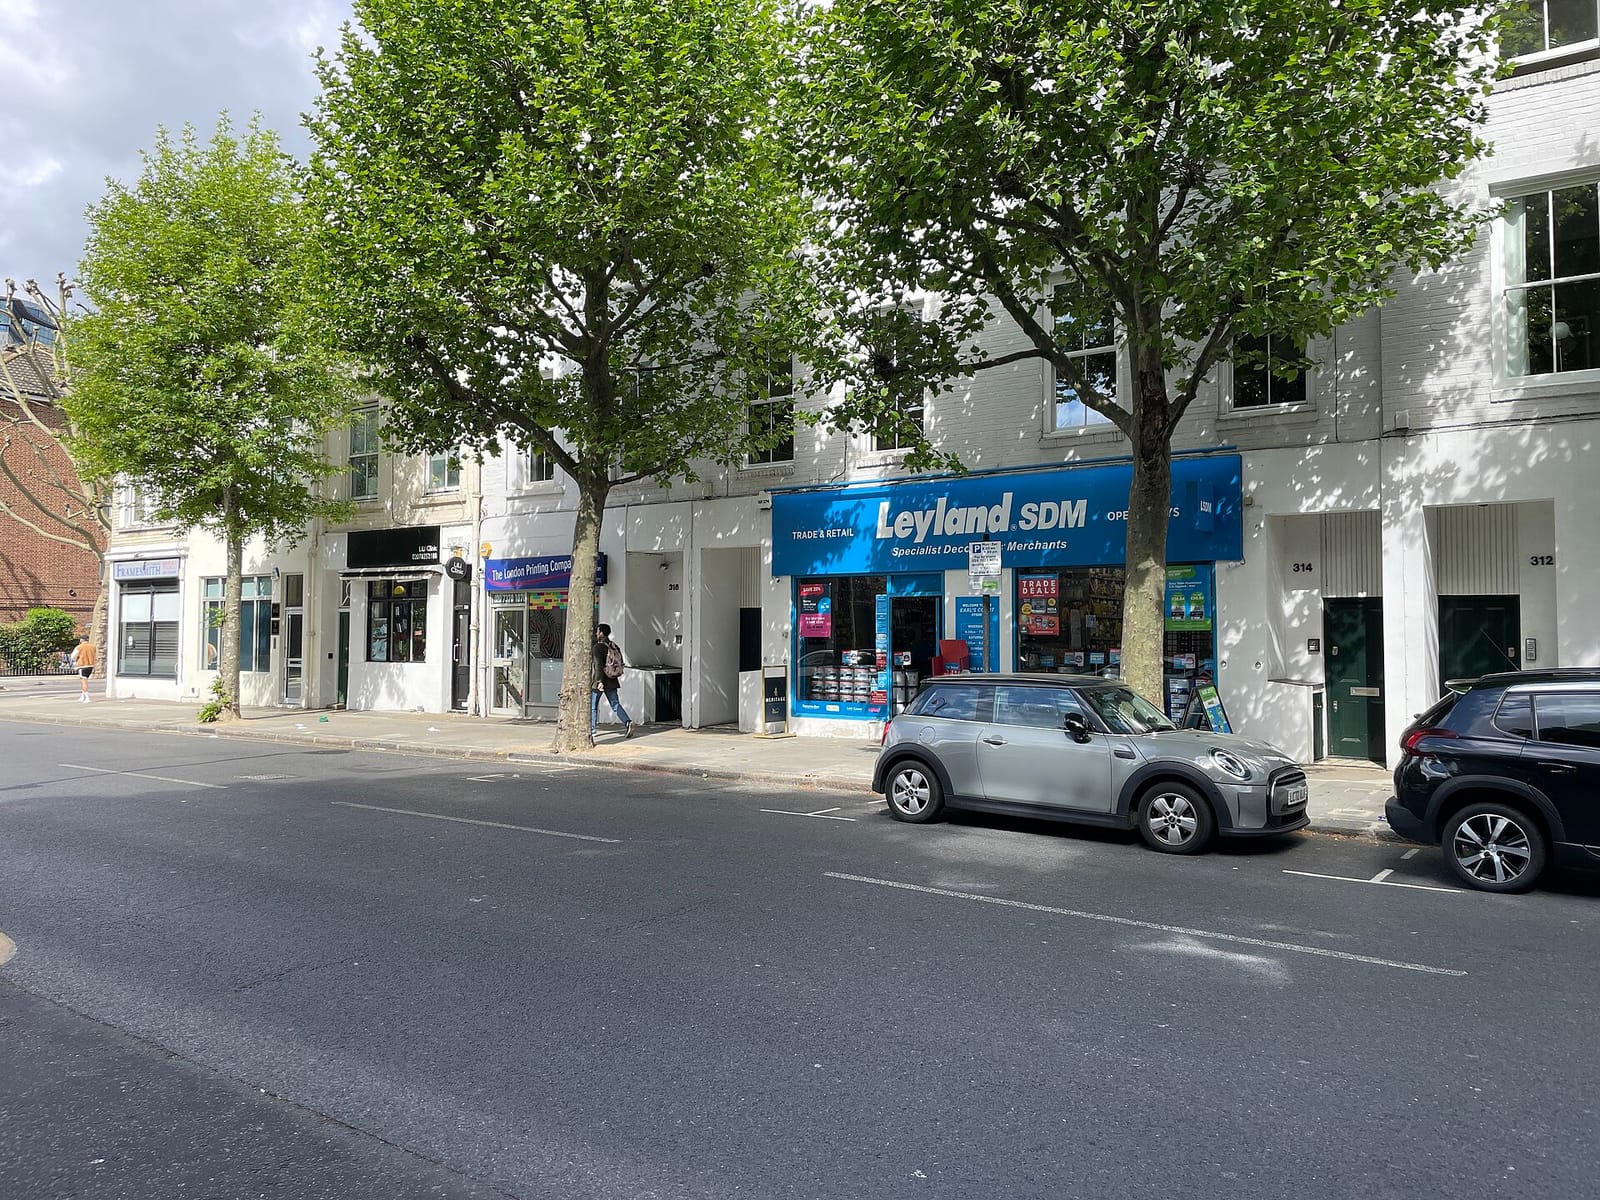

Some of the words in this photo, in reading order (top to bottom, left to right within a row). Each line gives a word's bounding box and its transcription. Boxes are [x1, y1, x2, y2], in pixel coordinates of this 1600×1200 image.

[876, 492, 1014, 543] Leyland
[1018, 499, 1088, 531] SDM
[1107, 511, 1129, 521] OPE
[792, 530, 818, 540] TRADE
[819, 530, 825, 538] &
[826, 528, 855, 538] RETAIL
[892, 545, 942, 557] Specialist
[1006, 540, 1068, 552] Merchants
[1530, 556, 1554, 566] 312
[492, 569, 503, 581] The
[504, 566, 525, 579] London
[526, 562, 549, 576] Printing
[550, 559, 572, 573] Compa
[1293, 563, 1313, 572] 314
[1022, 580, 1056, 588] TRADE
[1022, 587, 1056, 595] DEALS
